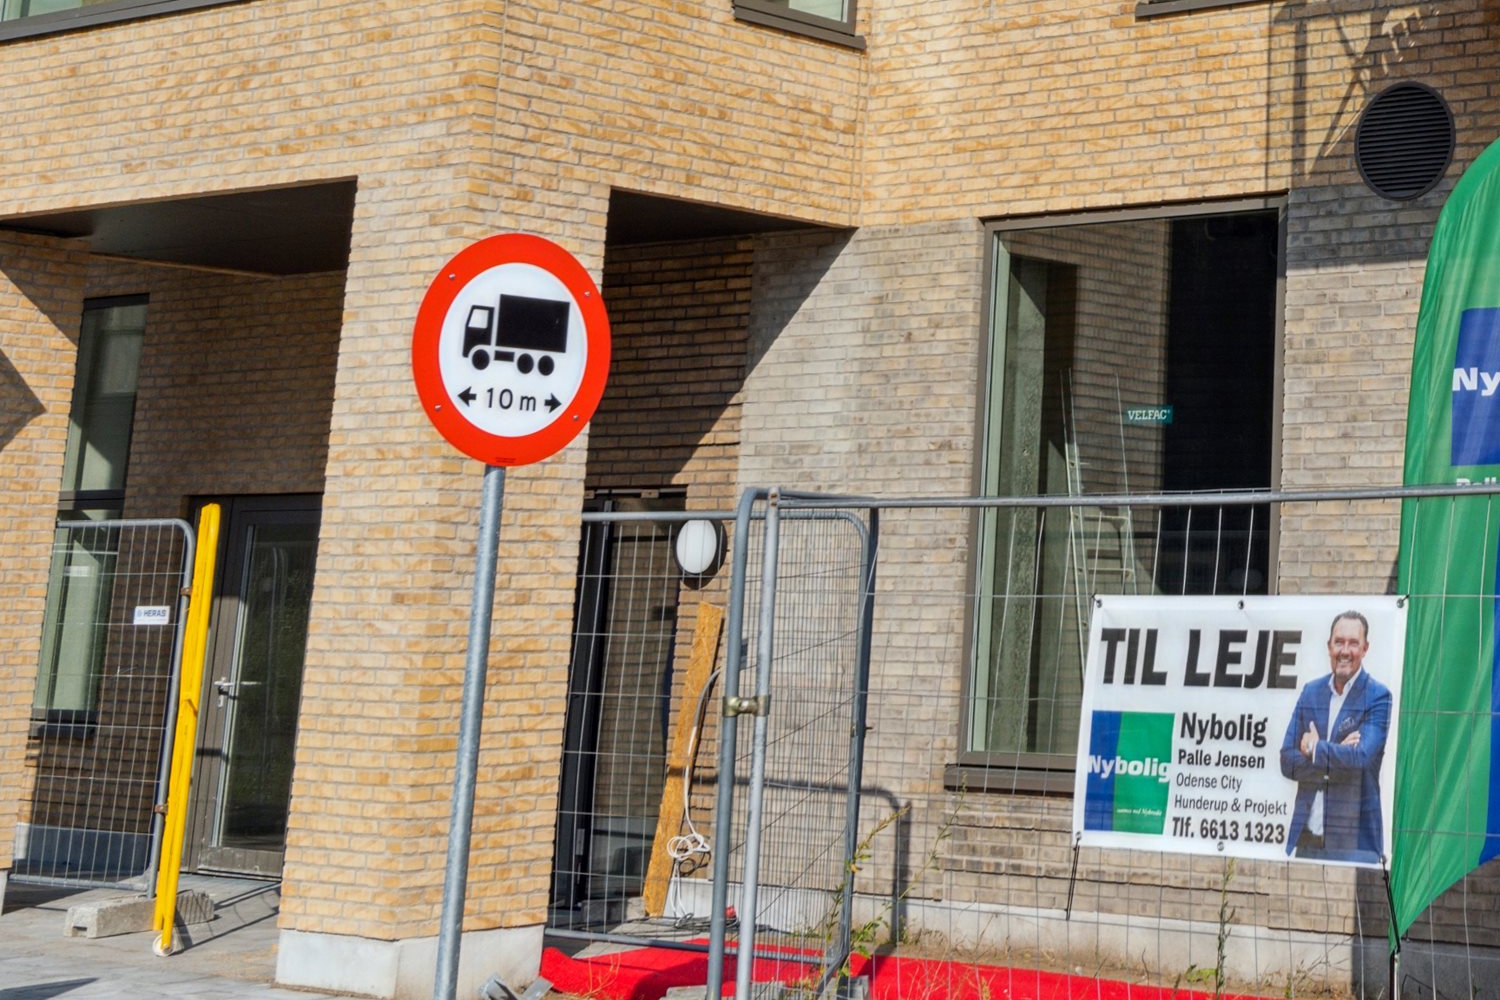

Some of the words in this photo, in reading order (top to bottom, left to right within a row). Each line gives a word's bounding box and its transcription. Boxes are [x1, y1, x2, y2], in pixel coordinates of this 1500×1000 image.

[486, 388, 513, 409] 10
[520, 395, 537, 411] m
[143, 609, 167, 617] HERAS
[1101, 627, 1167, 685] TIL
[1184, 629, 1302, 689] LEJE
[1180, 712, 1268, 748] Nybolig
[1087, 755, 1171, 783] Nybolig
[1178, 749, 1212, 767] Palle
[1215, 750, 1265, 769] Jensen
[1176, 772, 1217, 788] Odense
[1220, 774, 1242, 793] City
[1174, 794, 1228, 814] Hunderup
[1231, 798, 1241, 812] &
[1244, 799, 1287, 817] Projekt
[1172, 816, 1194, 838] Tlf.
[1200, 818, 1239, 841] 6613
[1244, 821, 1285, 844] 1323
